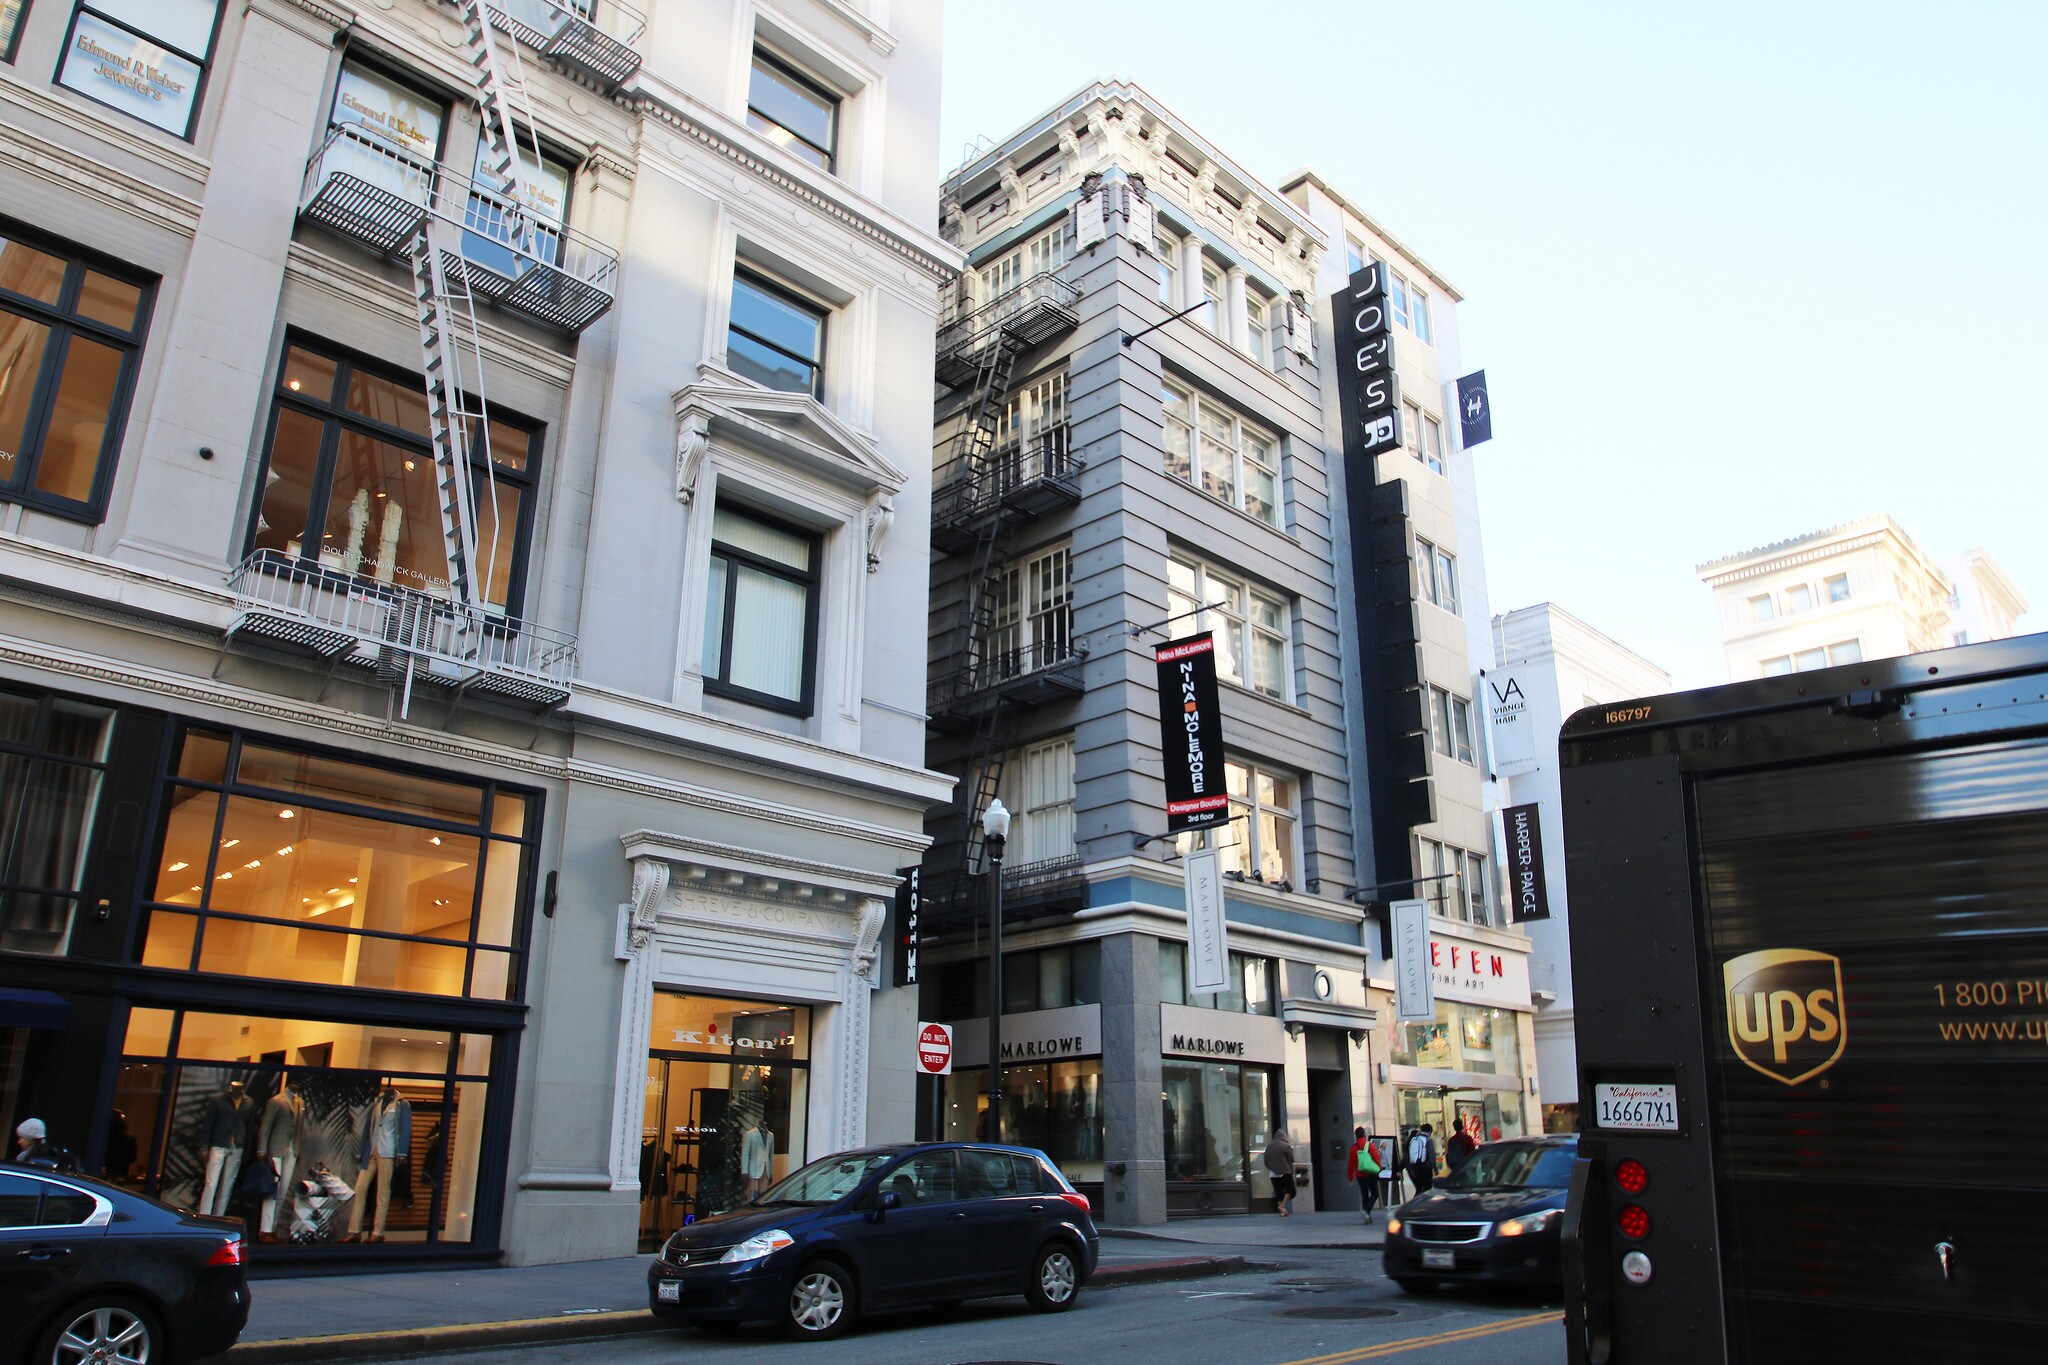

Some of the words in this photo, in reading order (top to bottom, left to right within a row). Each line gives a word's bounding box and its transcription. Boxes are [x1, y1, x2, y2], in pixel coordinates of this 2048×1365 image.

[77, 34, 133, 71] Edmund
[146, 64, 186, 95] Weber
[93, 62, 162, 101] Jewelers
[342, 92, 387, 125] Edmund
[397, 118, 430, 144] Weber
[358, 555, 409, 576] CHADWICK
[410, 570, 451, 588] GALLERY
[1158, 649, 1175, 661] Nina
[1175, 640, 1212, 659] McLemore
[1180, 661, 1196, 703] NINA
[1493, 702, 1526, 714] VIANGE
[1495, 715, 1517, 725] HAIR
[1184, 710, 1204, 793] MCLEMORE
[1169, 801, 1199, 813] Designer
[1200, 797, 1226, 809] Boutique
[1187, 813, 1199, 823] 3rd
[1200, 812, 1214, 822] floor
[1514, 811, 1532, 866] HARPER
[1520, 871, 1536, 914] PAIGE
[763, 906, 836, 931] COMPANY
[1200, 877, 1213, 963] MARLOWE
[1405, 923, 1418, 998] MARLOWE
[1465, 979, 1484, 990] ART
[1934, 983, 1945, 1007] 1
[1956, 981, 2007, 1007] 800
[671, 1023, 775, 1050] Kiton
[922, 1032, 932, 1041] DO
[934, 1034, 947, 1043] NOT
[1734, 988, 1839, 1064] ups
[1939, 1021, 2048, 1047] www.u
[1001, 1036, 1082, 1058] MARLOWE
[1172, 1033, 1245, 1057] MARLOWE
[924, 1054, 944, 1064] ENTER
[1612, 1086, 1660, 1100] California
[1602, 1100, 1675, 1123] 16667X1
[674, 1125, 718, 1134] Kiton
